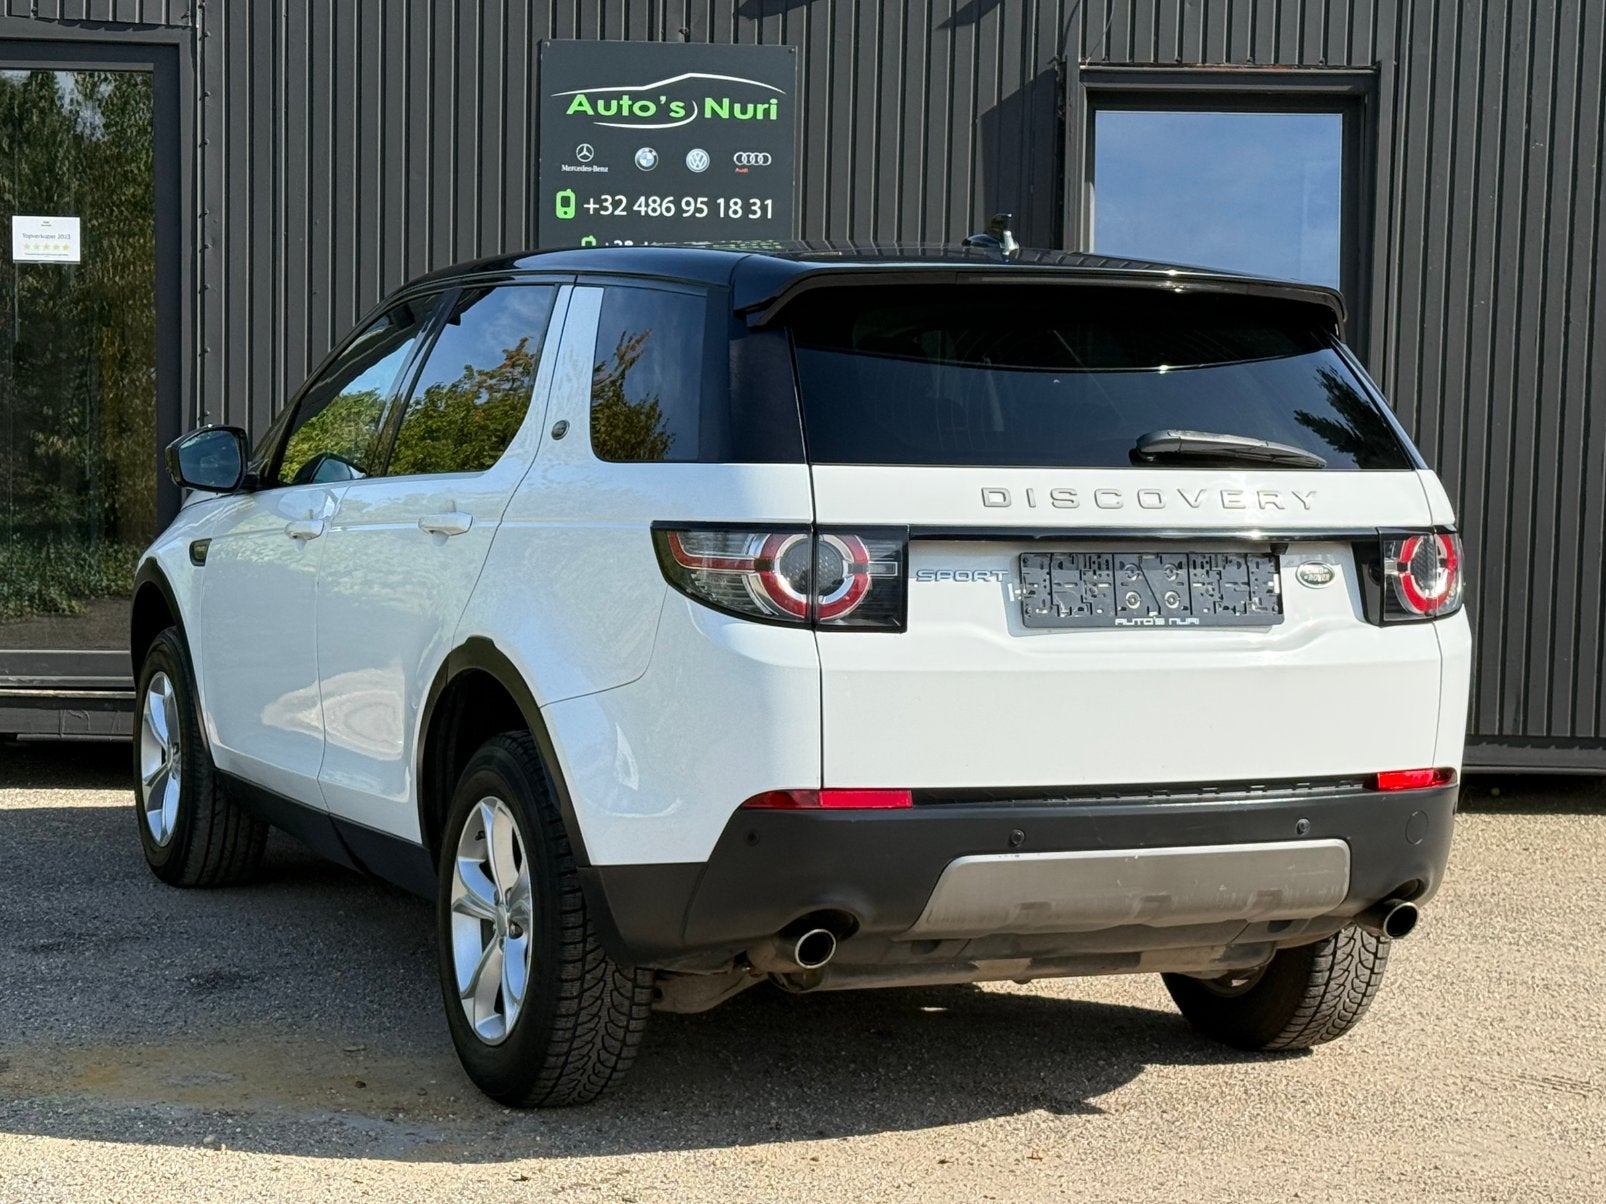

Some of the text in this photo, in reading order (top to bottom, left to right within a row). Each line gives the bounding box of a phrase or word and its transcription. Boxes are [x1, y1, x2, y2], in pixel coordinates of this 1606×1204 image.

[566, 94, 778, 120] Auto's Nuri
[561, 164, 609, 173] Mercedes-Benz
[583, 195, 772, 219] +32 486 95 18 31
[981, 486, 1320, 511] DISCOVERY
[916, 569, 1008, 582] SPORT
